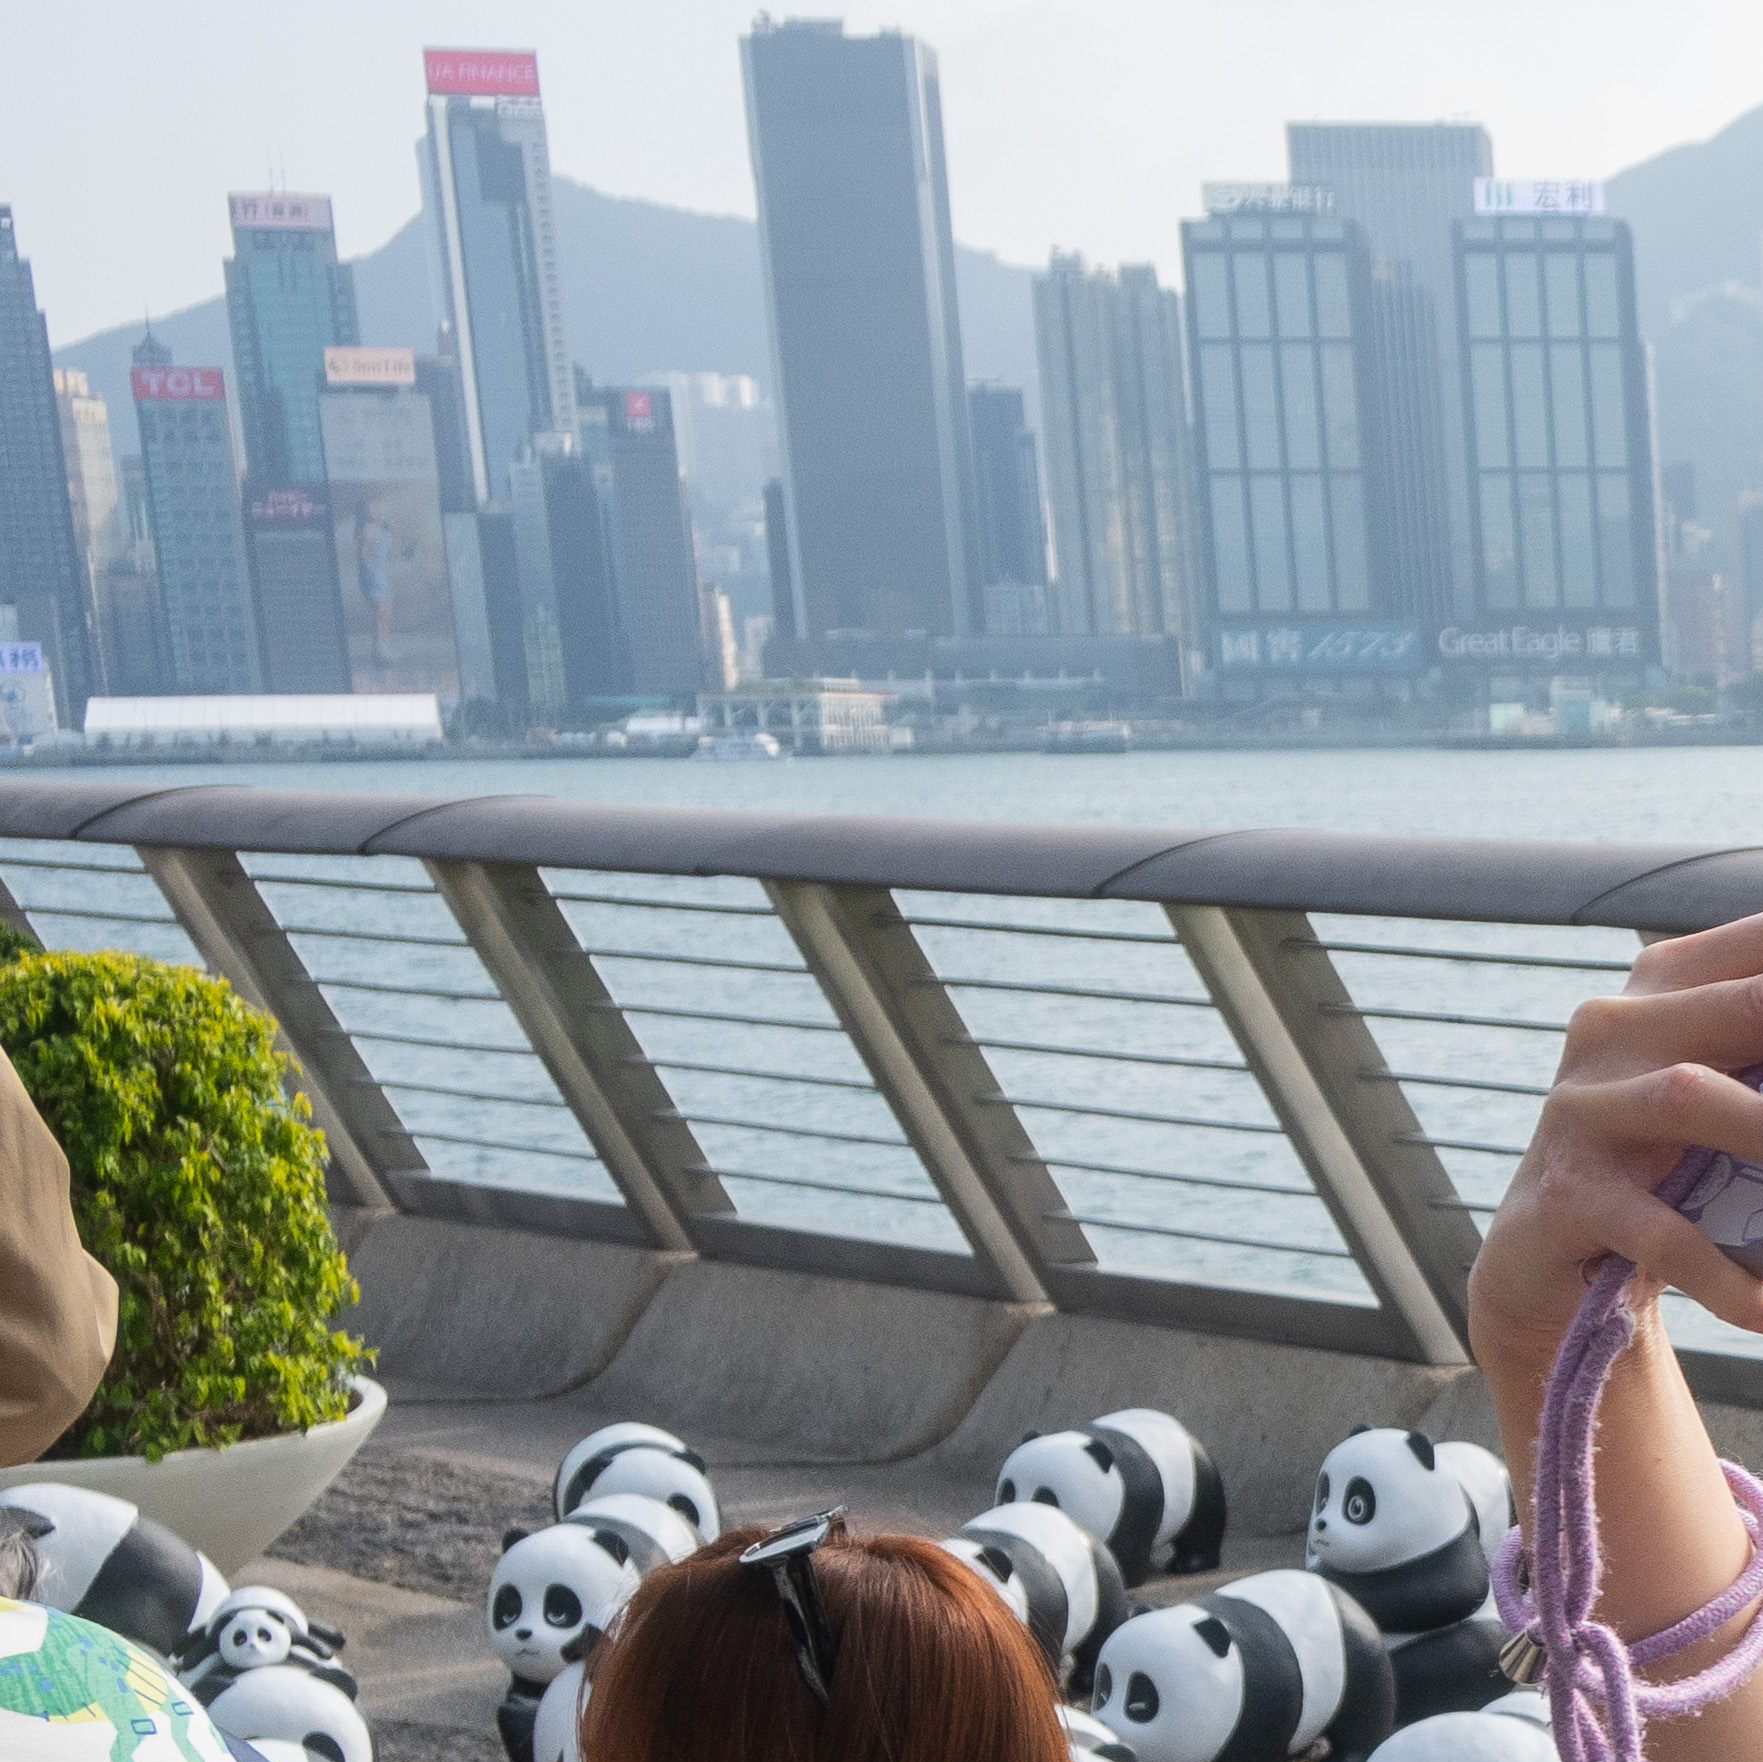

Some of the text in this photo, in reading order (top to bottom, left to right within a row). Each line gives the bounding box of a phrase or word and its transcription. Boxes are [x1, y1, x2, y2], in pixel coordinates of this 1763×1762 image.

[458, 62, 535, 83] FINANCE
[1533, 181, 1594, 208] 宏利
[140, 370, 214, 397] TCL
[1308, 631, 1413, 661] 1573
[1439, 627, 1506, 657] Great
[1512, 625, 1582, 660] Eagle
